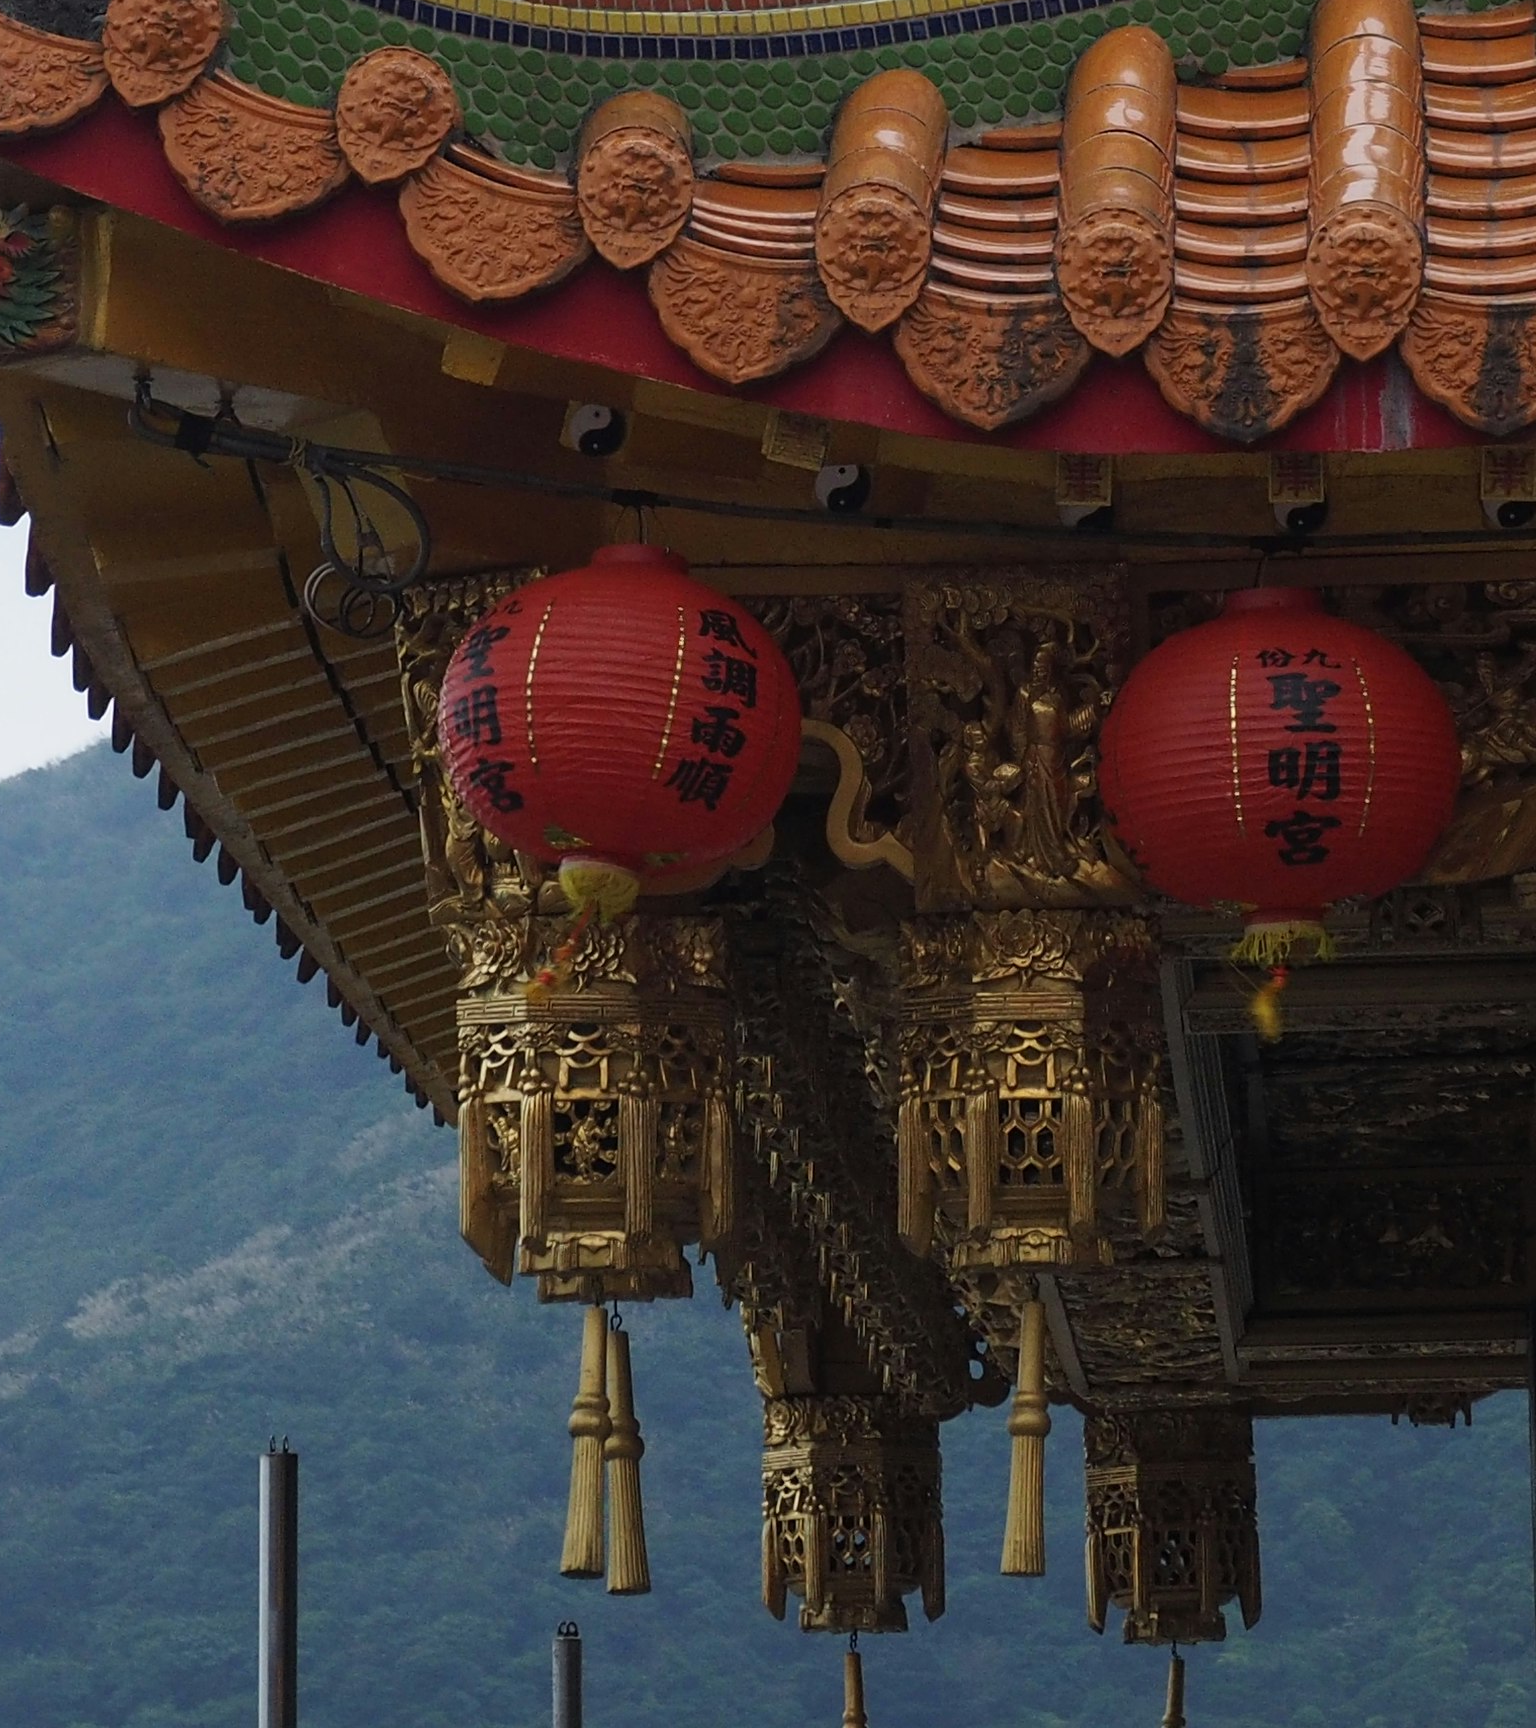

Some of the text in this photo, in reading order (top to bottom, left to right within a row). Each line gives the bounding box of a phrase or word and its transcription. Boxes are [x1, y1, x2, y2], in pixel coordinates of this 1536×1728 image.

[663, 609, 758, 812] 風調雨順
[1255, 648, 1343, 671] 九份
[1263, 672, 1344, 867] 聖明宮
